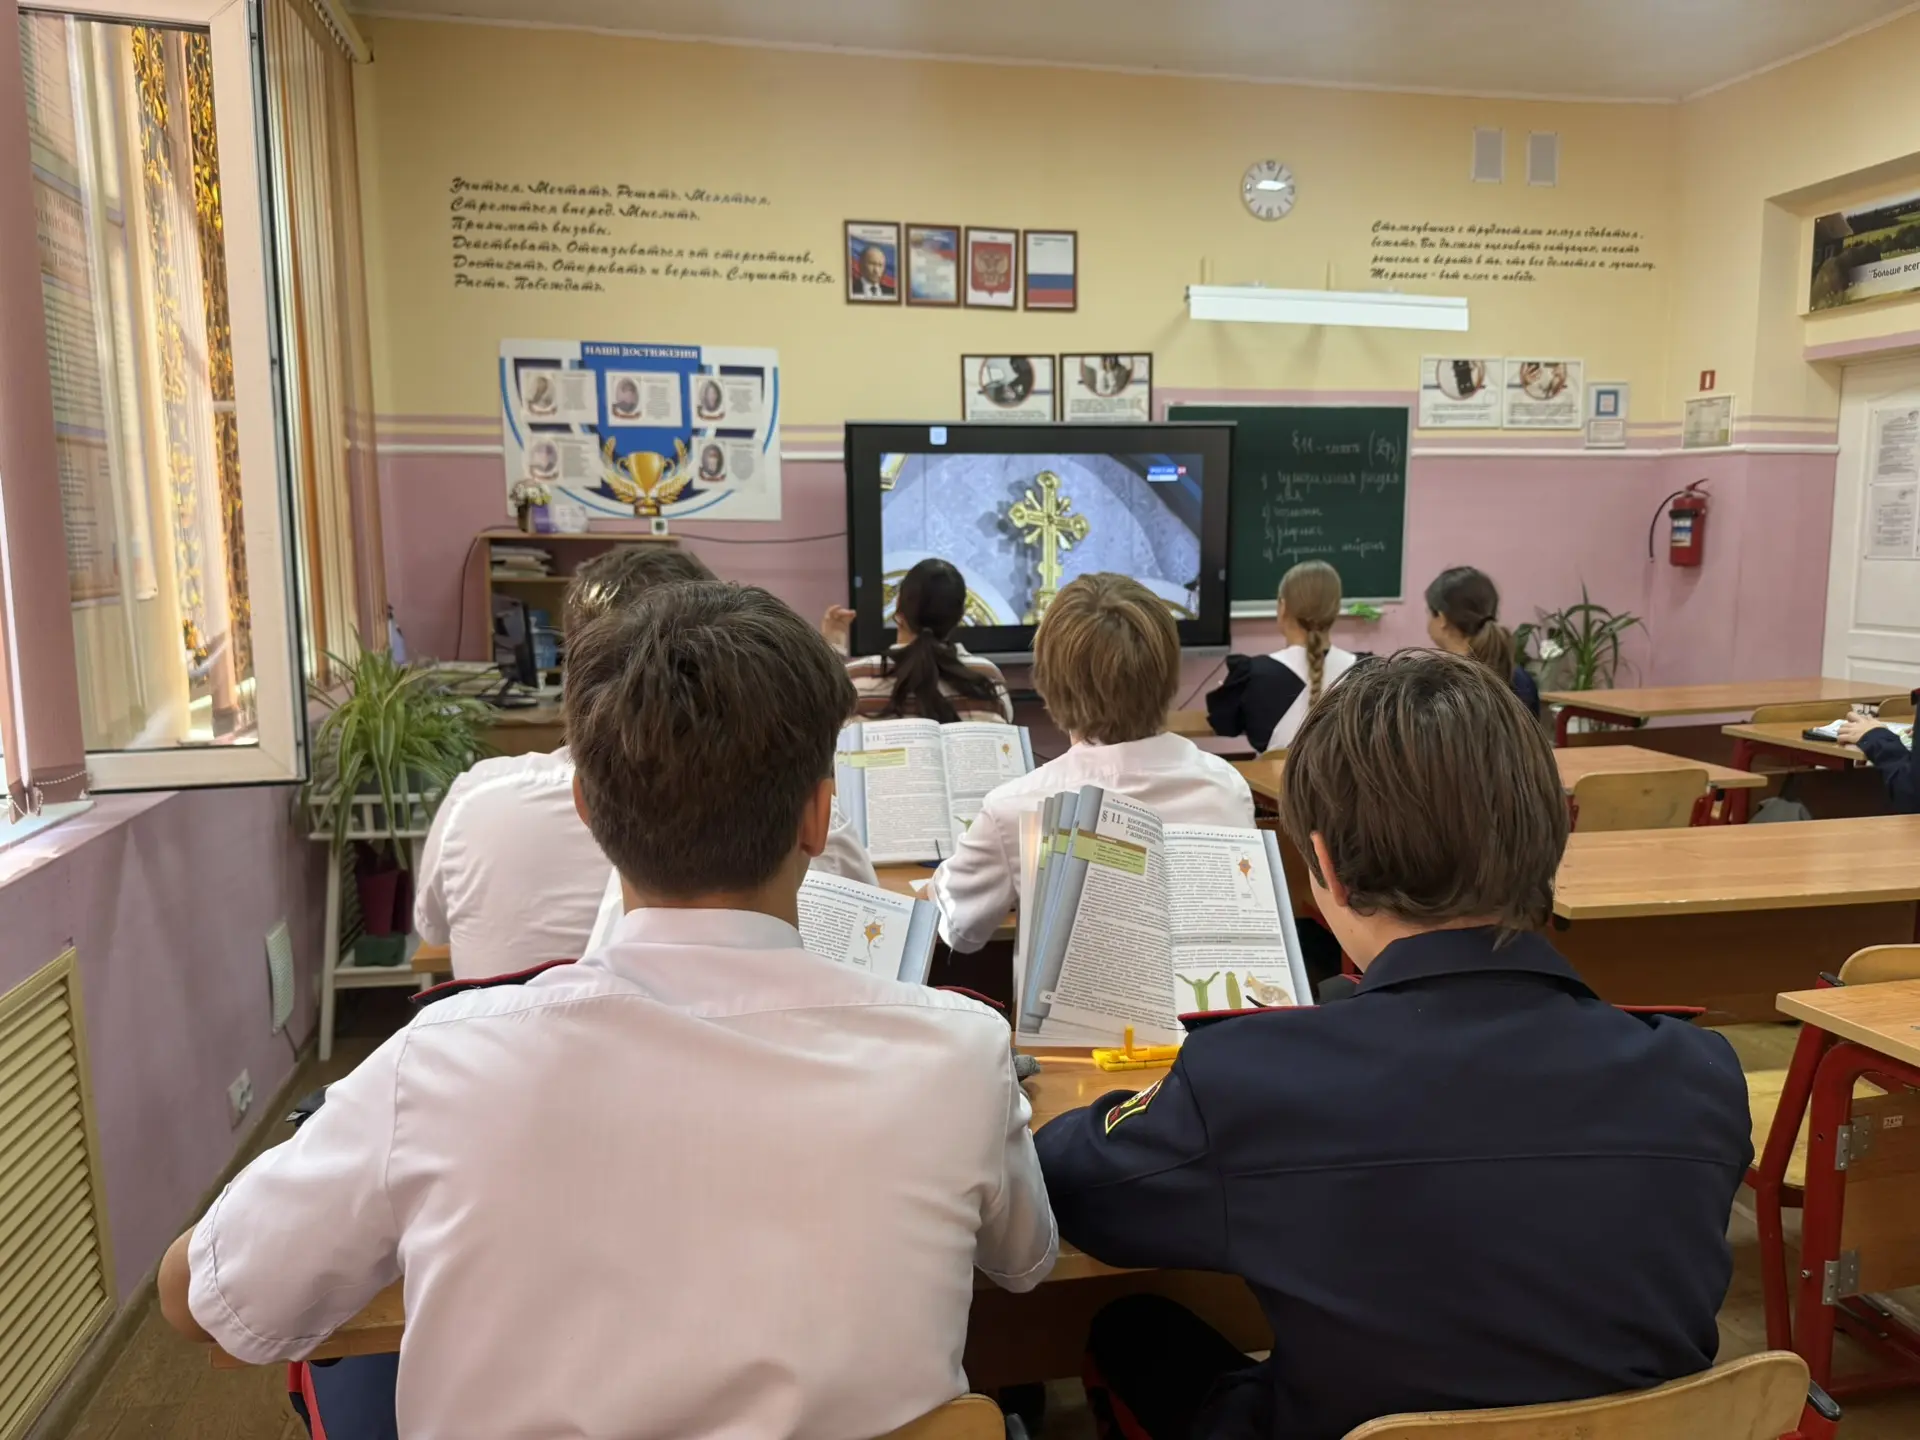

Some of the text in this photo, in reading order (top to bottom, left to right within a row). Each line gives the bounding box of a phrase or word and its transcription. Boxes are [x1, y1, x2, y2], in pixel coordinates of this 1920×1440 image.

[528, 180, 612, 198] Мечтать.
[616, 184, 681, 201] Решать.
[450, 197, 557, 214] Стремиться
[451, 216, 611, 237] Принимать вызовы.
[566, 240, 684, 258] Отказываться
[688, 249, 708, 258] от
[552, 258, 647, 275] Открывать
[651, 267, 660, 275] и
[726, 266, 798, 283] Слушать
[585, 344, 698, 359] НАШИ ДОСТИЖЕНИЯ
[1111, 812, 1124, 825] 11.
